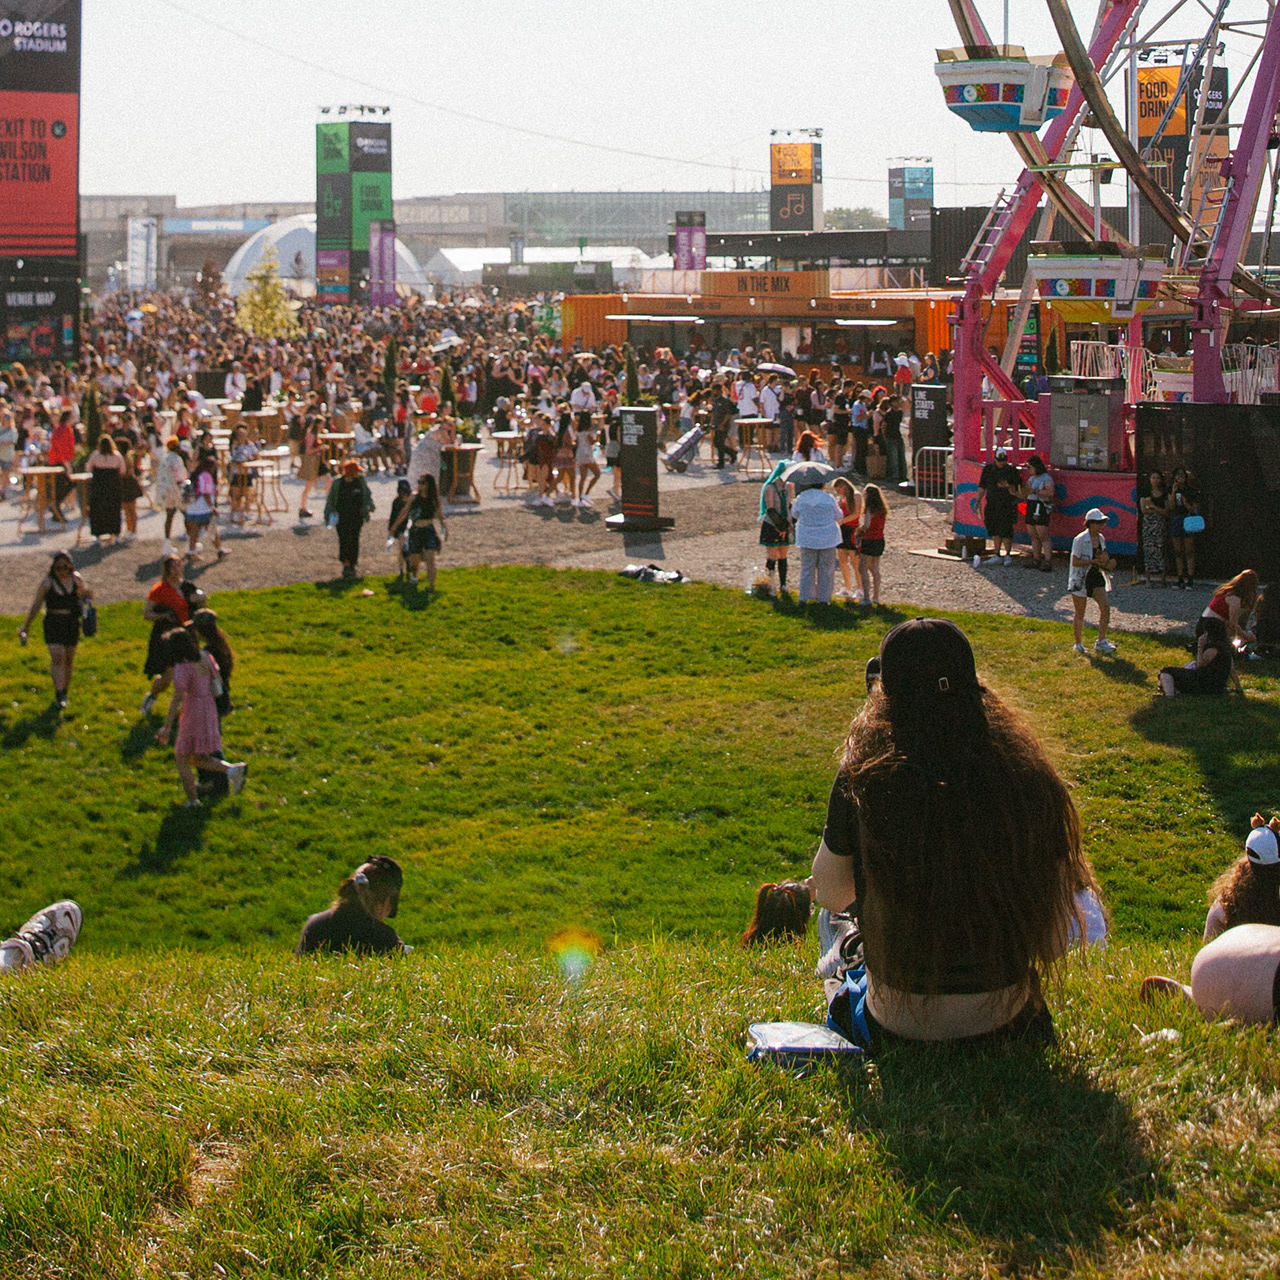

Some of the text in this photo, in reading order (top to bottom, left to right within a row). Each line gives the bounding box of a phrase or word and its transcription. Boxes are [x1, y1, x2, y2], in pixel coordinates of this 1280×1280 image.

[14, 21, 67, 38] ROGERS
[14, 38, 67, 53] STADIUM
[1140, 82, 1168, 99] FOOD
[1207, 91, 1222, 99] GERS
[1140, 100, 1169, 118] DRIN
[29, 119, 47, 139] TO
[738, 277, 790, 291] IN THE MIX
[915, 391, 927, 399] LINE
[915, 401, 934, 409] STARTS
[915, 410, 929, 419] HERE
